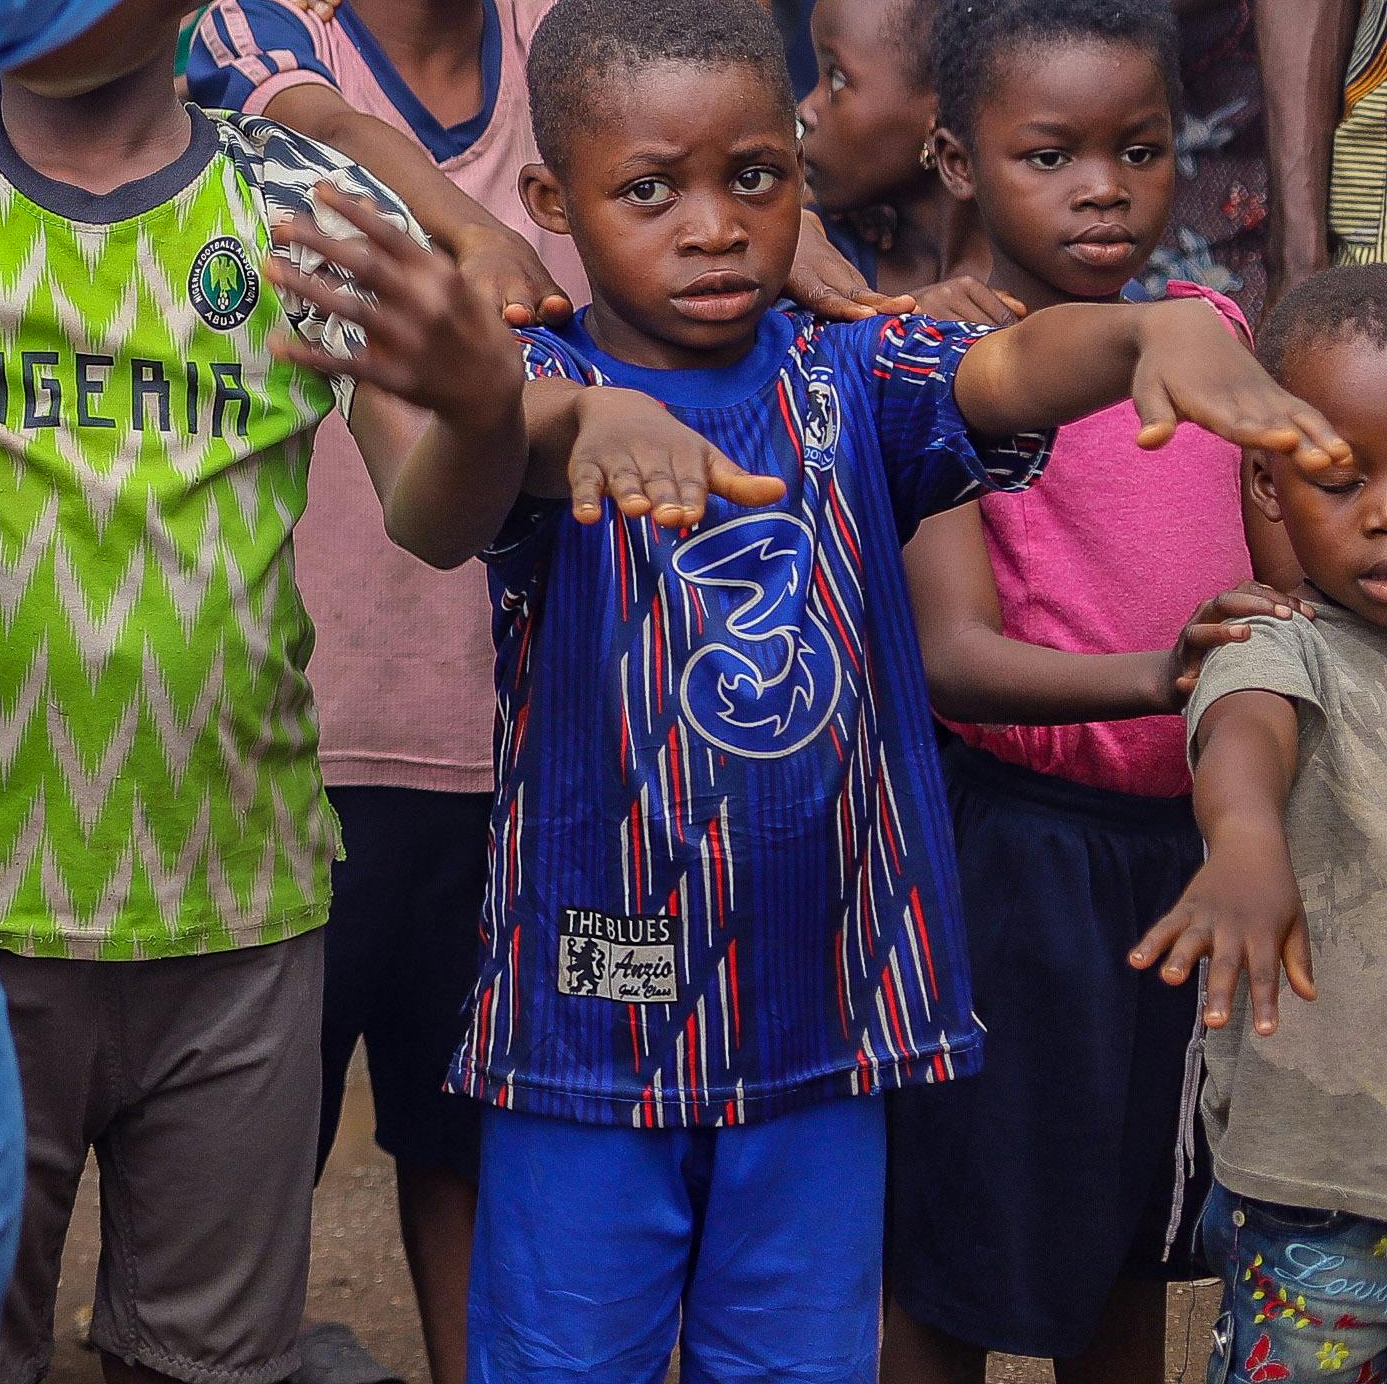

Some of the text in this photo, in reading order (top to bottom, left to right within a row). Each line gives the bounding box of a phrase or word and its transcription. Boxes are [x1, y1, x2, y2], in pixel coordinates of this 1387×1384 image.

[191, 269, 203, 304] NIGERIA
[198, 240, 235, 266] FOOTBALL
[204, 311, 246, 326] ABUJA
[611, 949, 673, 989] Anzio
